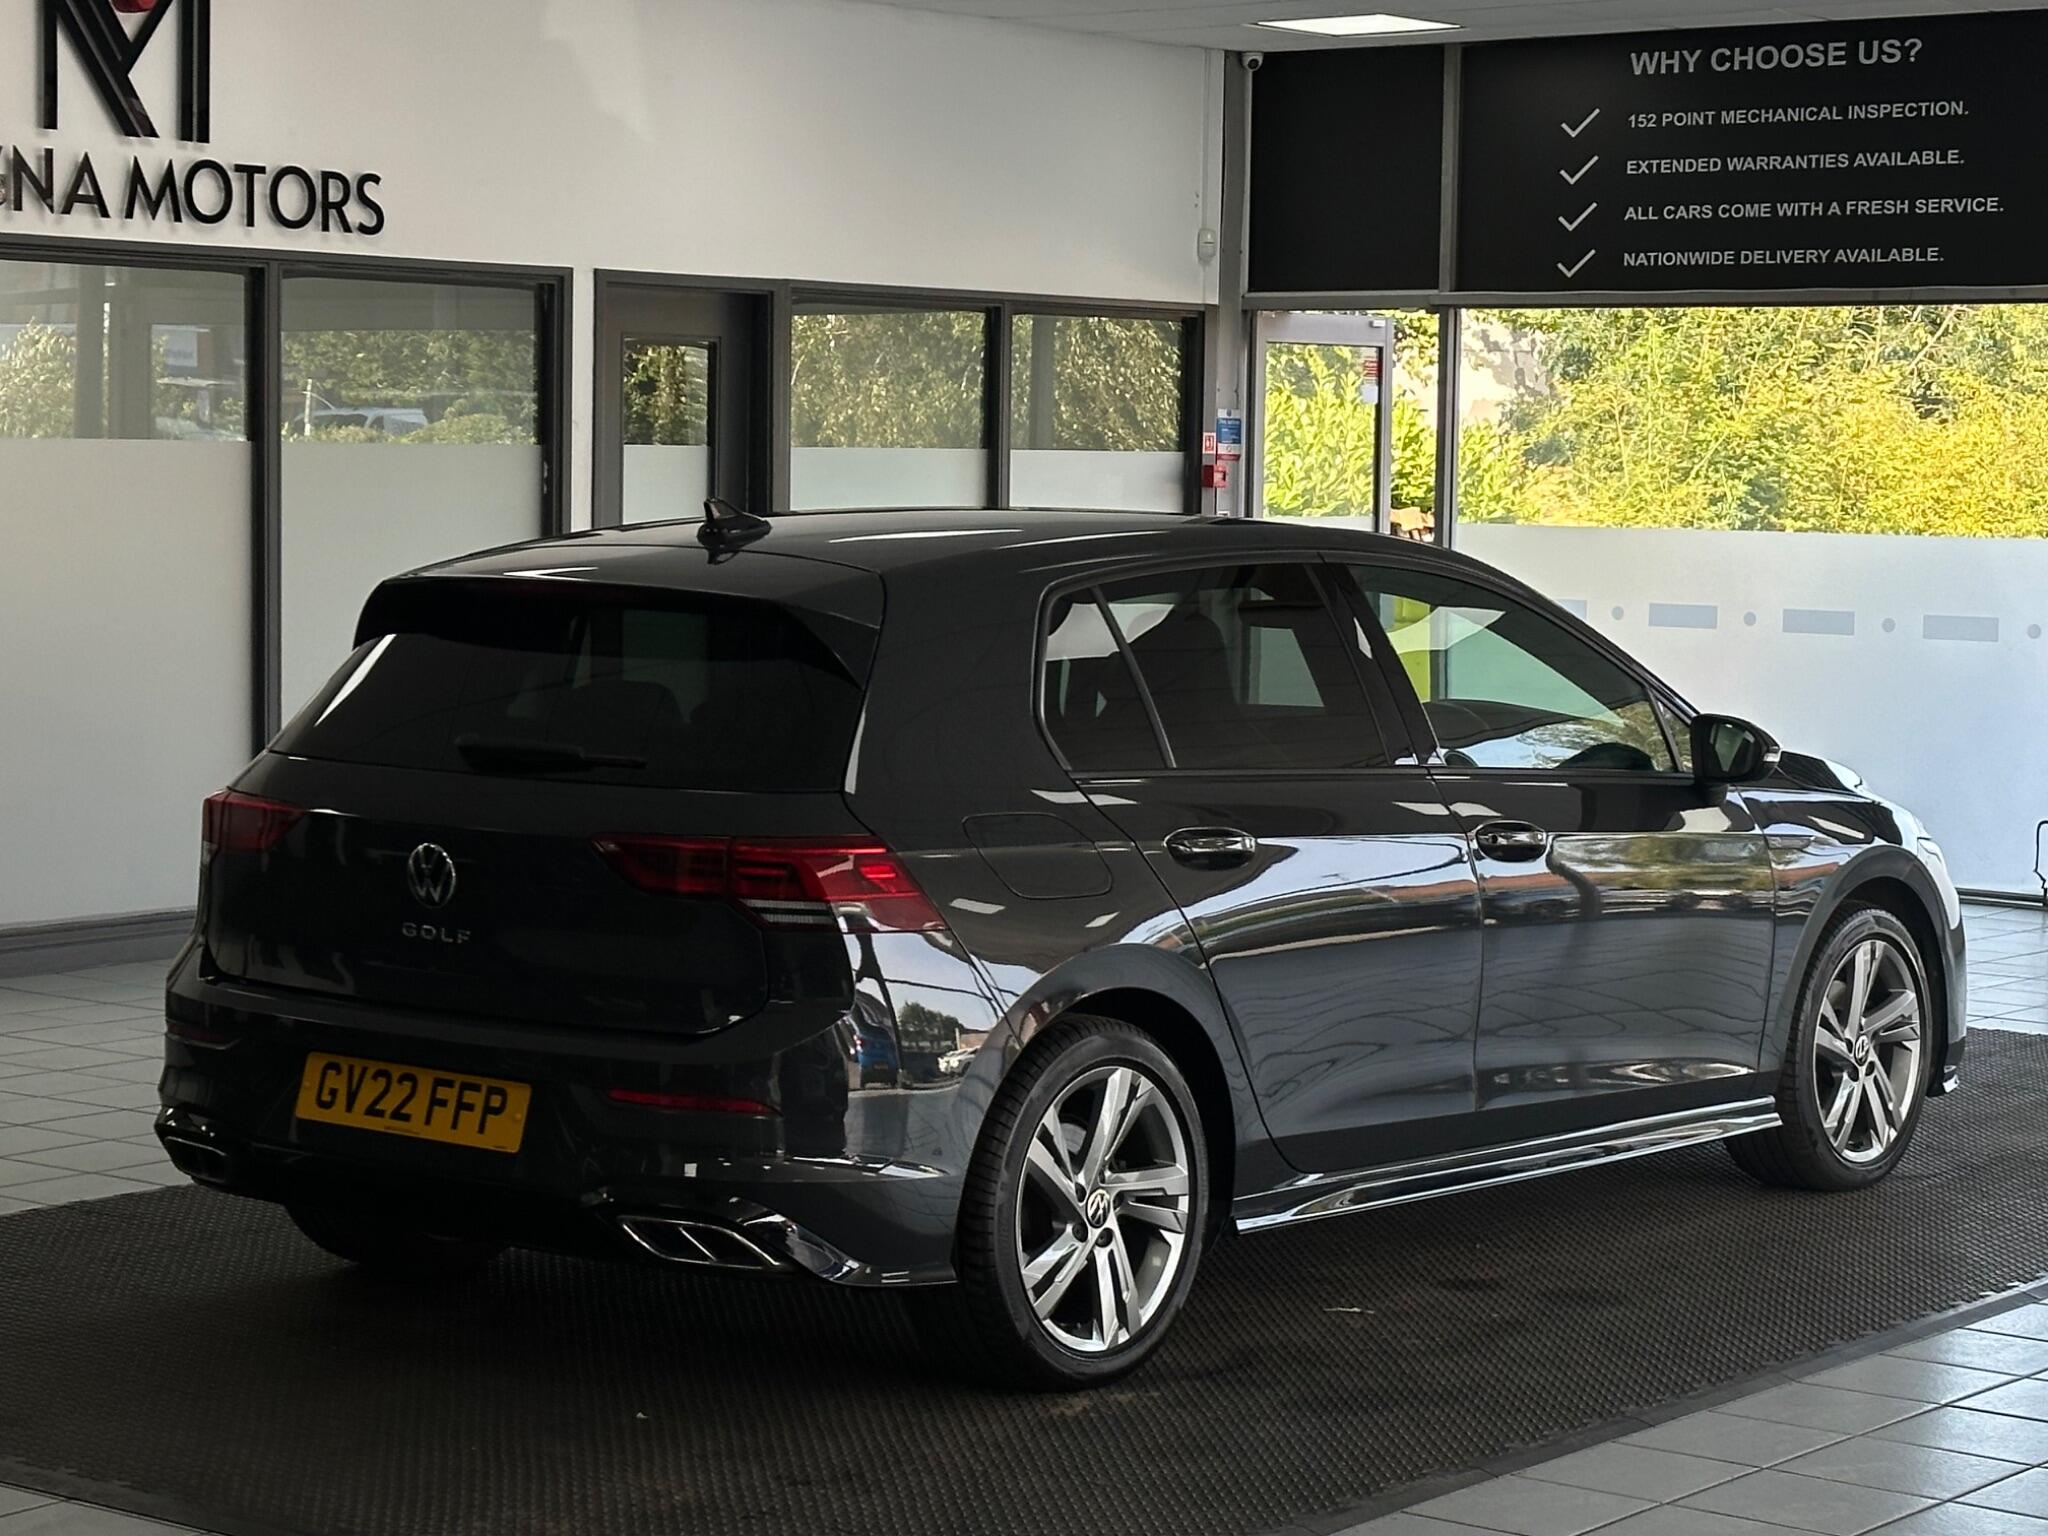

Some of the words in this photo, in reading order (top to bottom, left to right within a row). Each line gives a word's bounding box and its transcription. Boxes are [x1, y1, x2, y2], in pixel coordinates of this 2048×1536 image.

[1630, 48, 1702, 76] WHY
[1710, 41, 1847, 72] CHOOSE
[1858, 38, 1923, 65] US?
[1628, 113, 1657, 129] 152
[1661, 110, 1716, 127] POINT
[1720, 105, 1844, 125] MECHANICAL
[1847, 100, 1970, 120] INSPECTION.
[1626, 157, 1722, 175] EXTENDED
[1726, 153, 1850, 172] WARRANTIES
[1853, 149, 1965, 168] AVAILABLE.
[124, 155, 385, 236] MOTORS
[1623, 206, 1660, 221] ALL
[1663, 204, 1713, 220] CARS
[1717, 202, 1773, 219] COME
[1776, 202, 1824, 217] WITH
[1827, 201, 1842, 216] A
[1846, 199, 1910, 215] FRESH
[1914, 196, 2005, 214] SERVICE.
[1623, 250, 1736, 267] NATIONWIDE
[1740, 249, 1832, 265] DELIVERY
[1833, 247, 1945, 264] AVAILABLE.
[402, 921, 471, 944] GOLF
[315, 1060, 420, 1123] GV22
[424, 1076, 509, 1136] FFP
